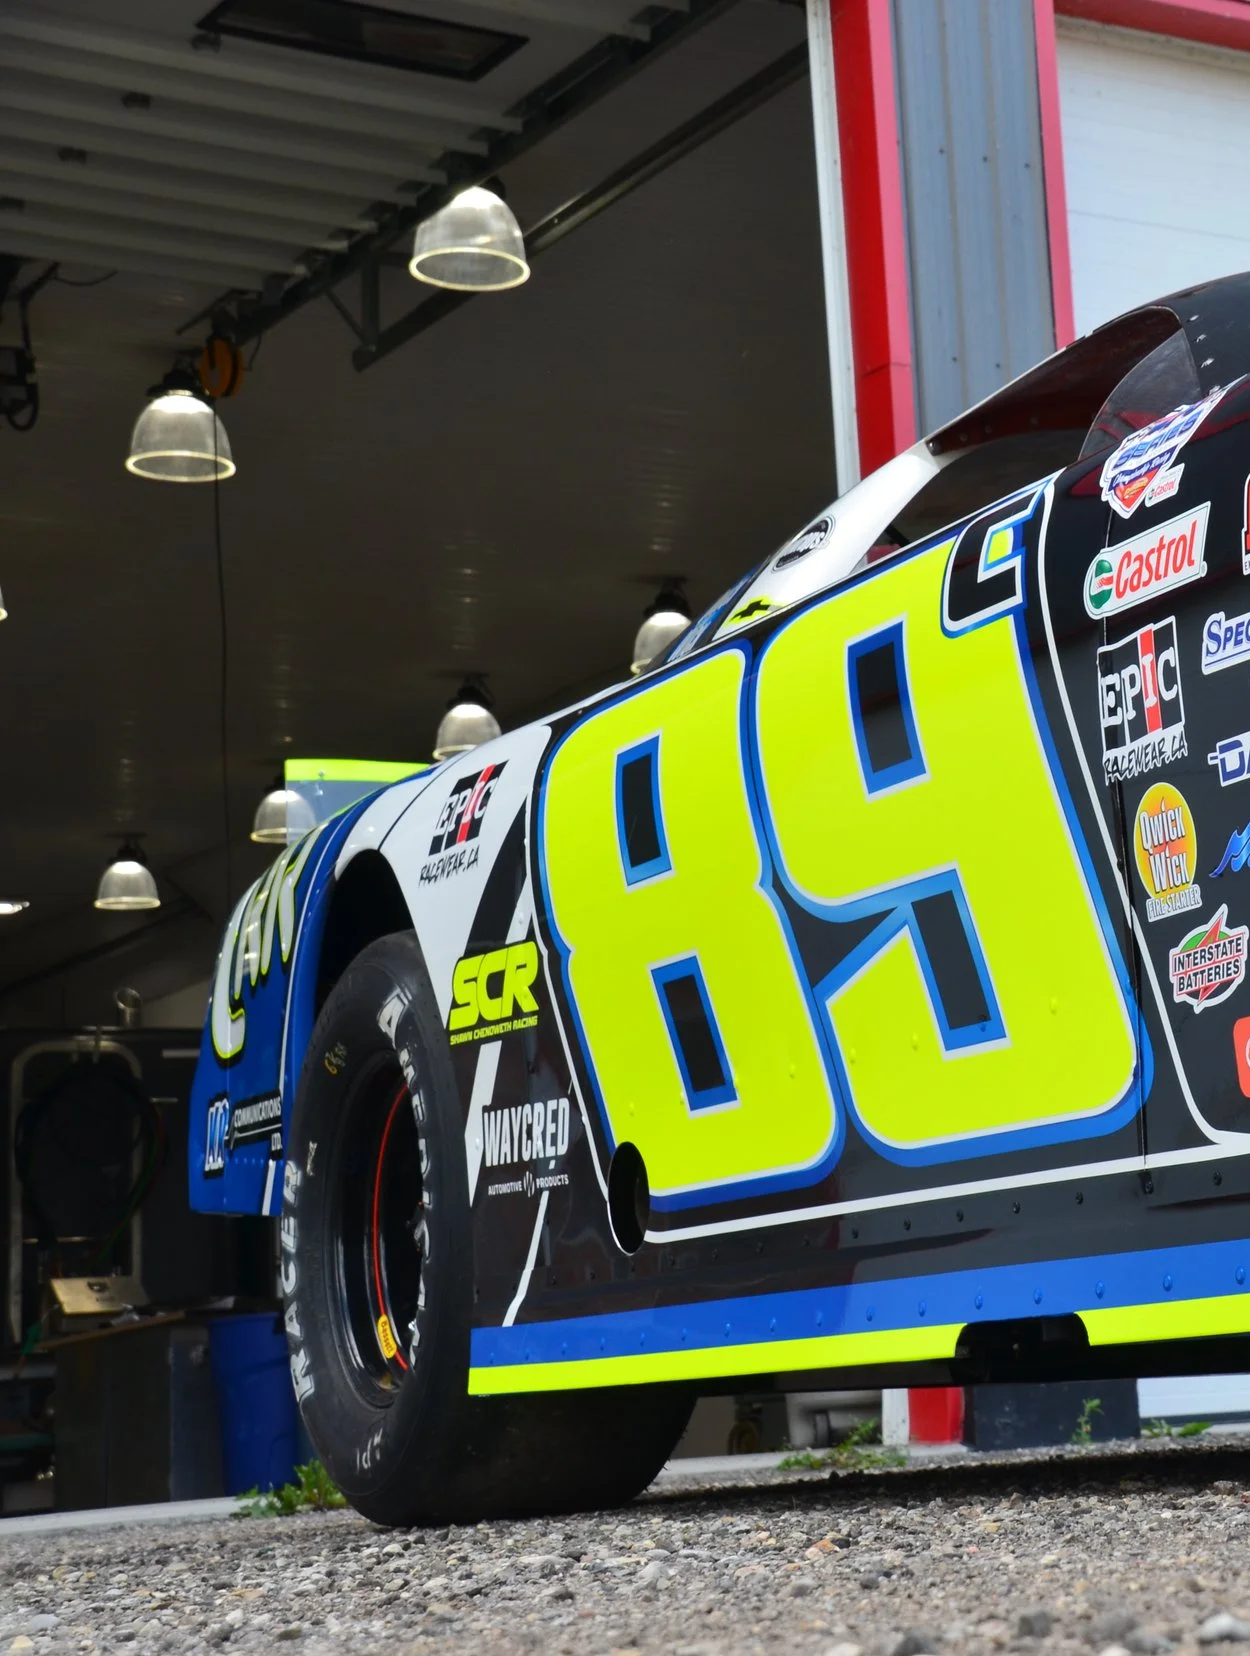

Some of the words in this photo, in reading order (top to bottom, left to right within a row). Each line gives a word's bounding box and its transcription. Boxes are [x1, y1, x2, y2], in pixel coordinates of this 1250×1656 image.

[1114, 520, 1197, 599] Castrol
[1101, 646, 1178, 728] EPIC
[434, 777, 493, 838] EPIC
[449, 941, 539, 1031] SCR
[1173, 936, 1242, 972] INTERSTATE
[1178, 959, 1240, 992] BATTERIES
[512, 1015, 538, 1031] RACING
[484, 1098, 570, 1167] WAYCRED
[488, 1180, 522, 1195] AUTOMOTIVE
[536, 1174, 569, 1188] PRODUCTS
[281, 1160, 315, 1402] RACER
